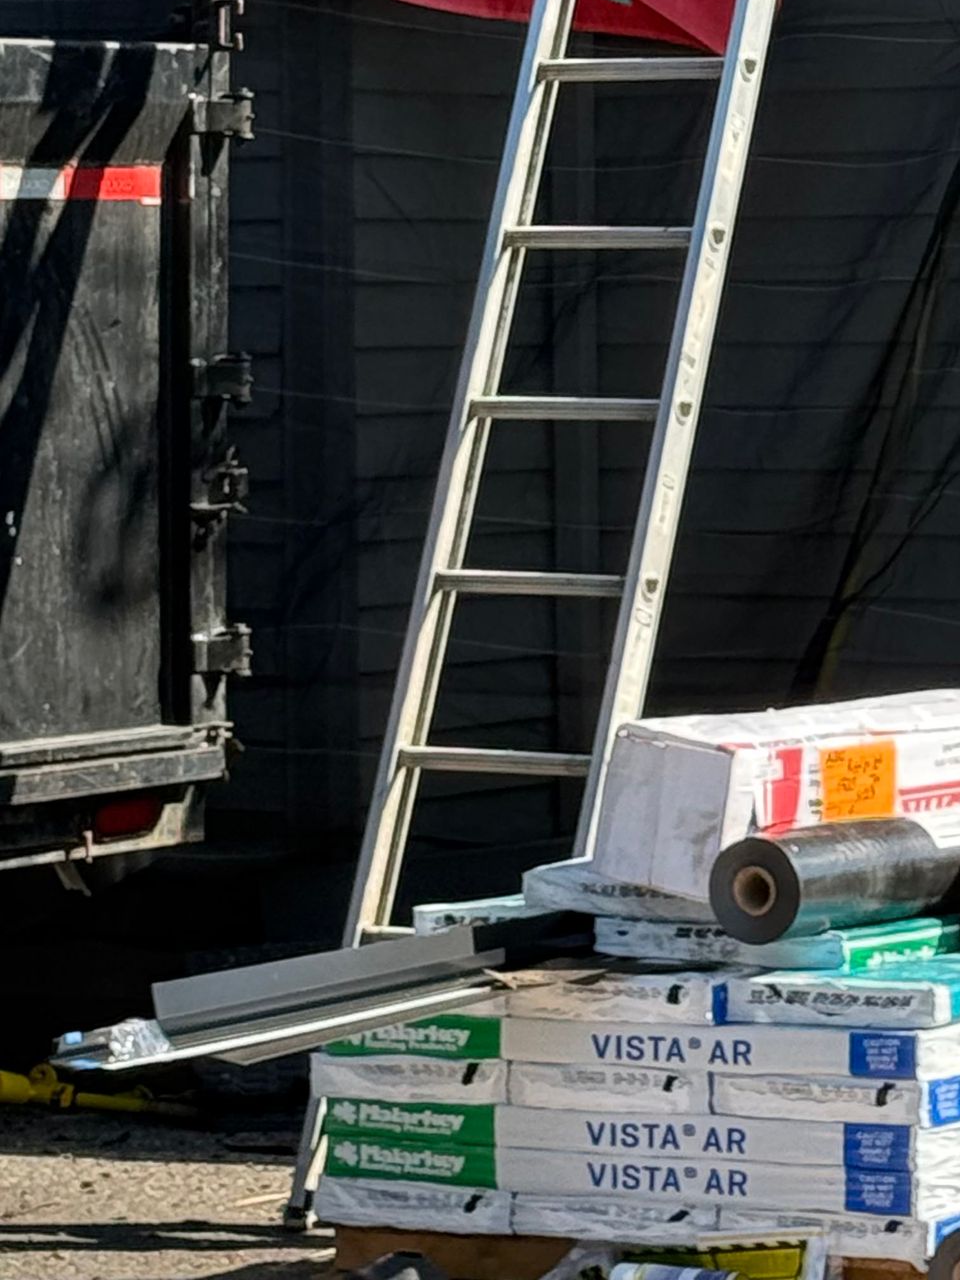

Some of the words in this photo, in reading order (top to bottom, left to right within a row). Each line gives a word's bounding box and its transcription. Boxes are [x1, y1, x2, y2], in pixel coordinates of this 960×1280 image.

[708, 1038, 752, 1066] AR
[703, 1126, 746, 1155] AR
[703, 1168, 748, 1197] AR
